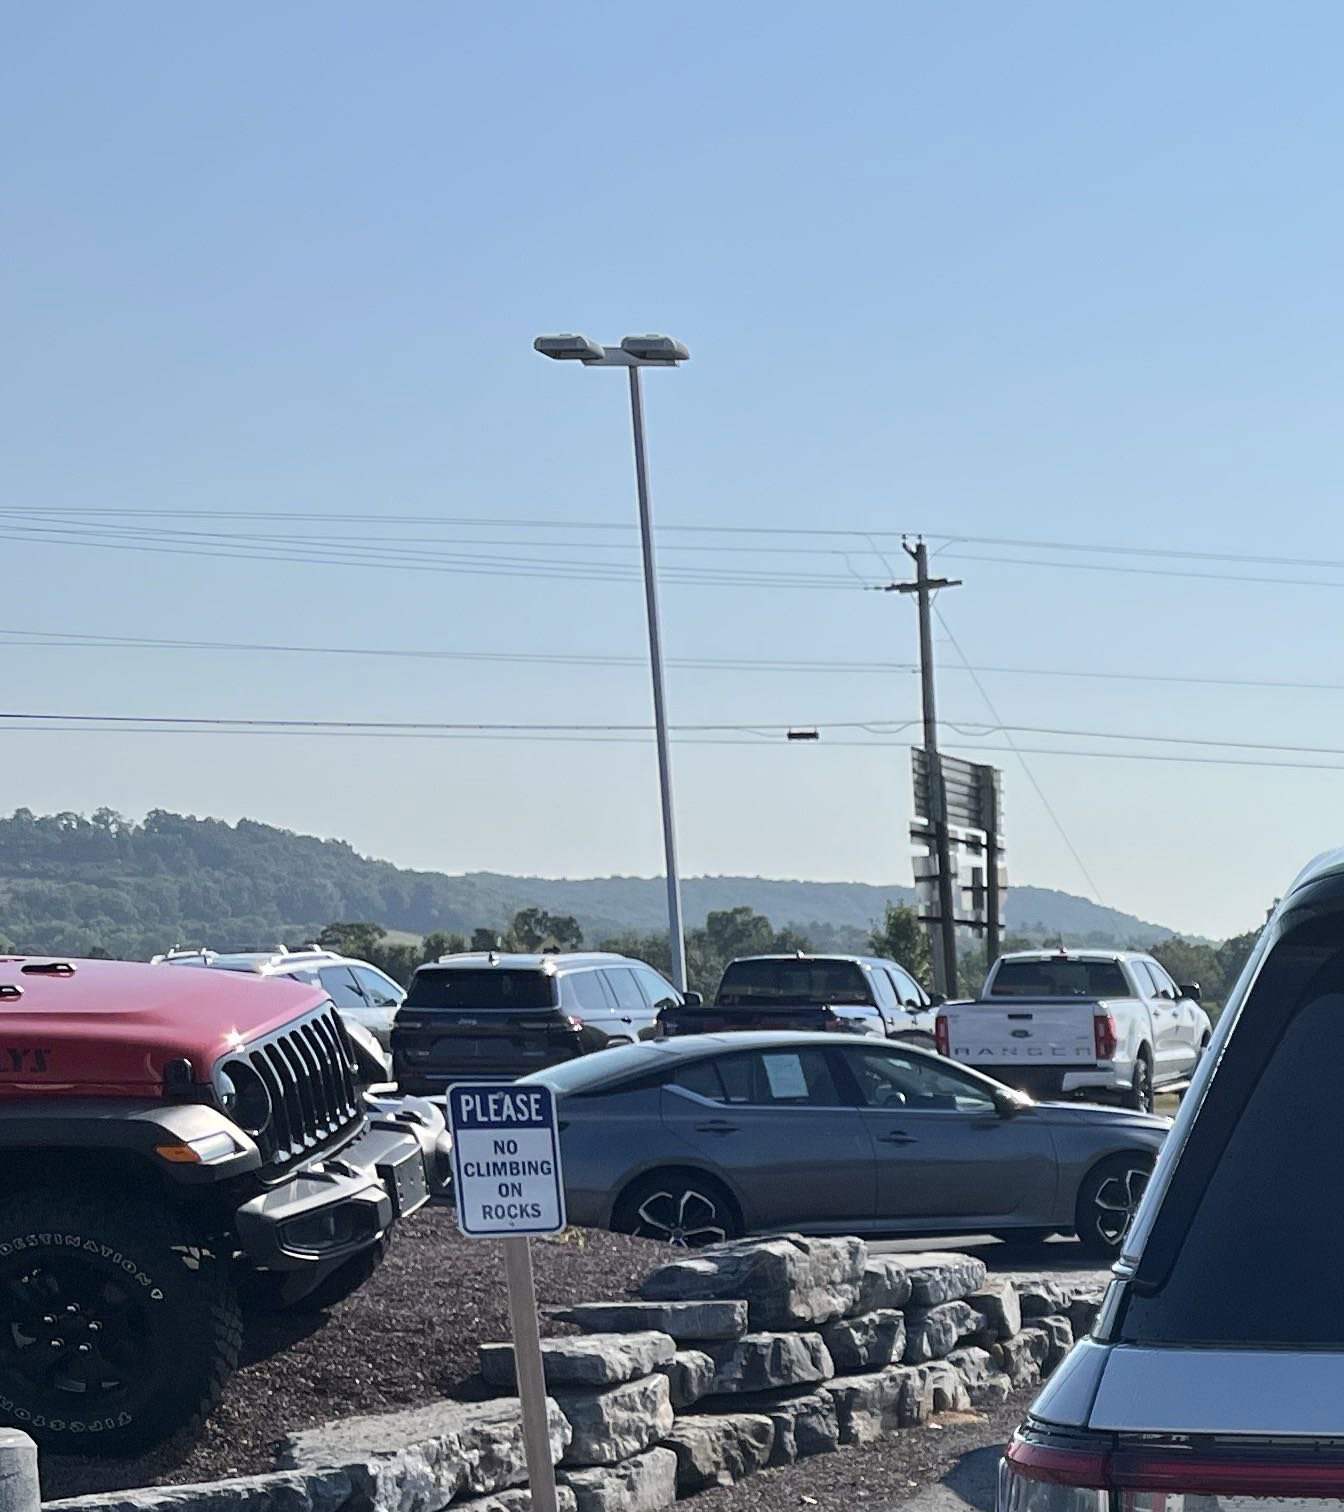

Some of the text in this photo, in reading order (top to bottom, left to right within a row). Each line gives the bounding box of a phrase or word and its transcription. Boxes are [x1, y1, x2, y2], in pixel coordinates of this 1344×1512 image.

[954, 1046, 1092, 1057] RANGER
[460, 1093, 544, 1122] PLEASE
[493, 1139, 518, 1155] NO
[463, 1160, 552, 1178] CLIMBING
[498, 1182, 522, 1198] ON
[481, 1203, 542, 1220] ROCKS
